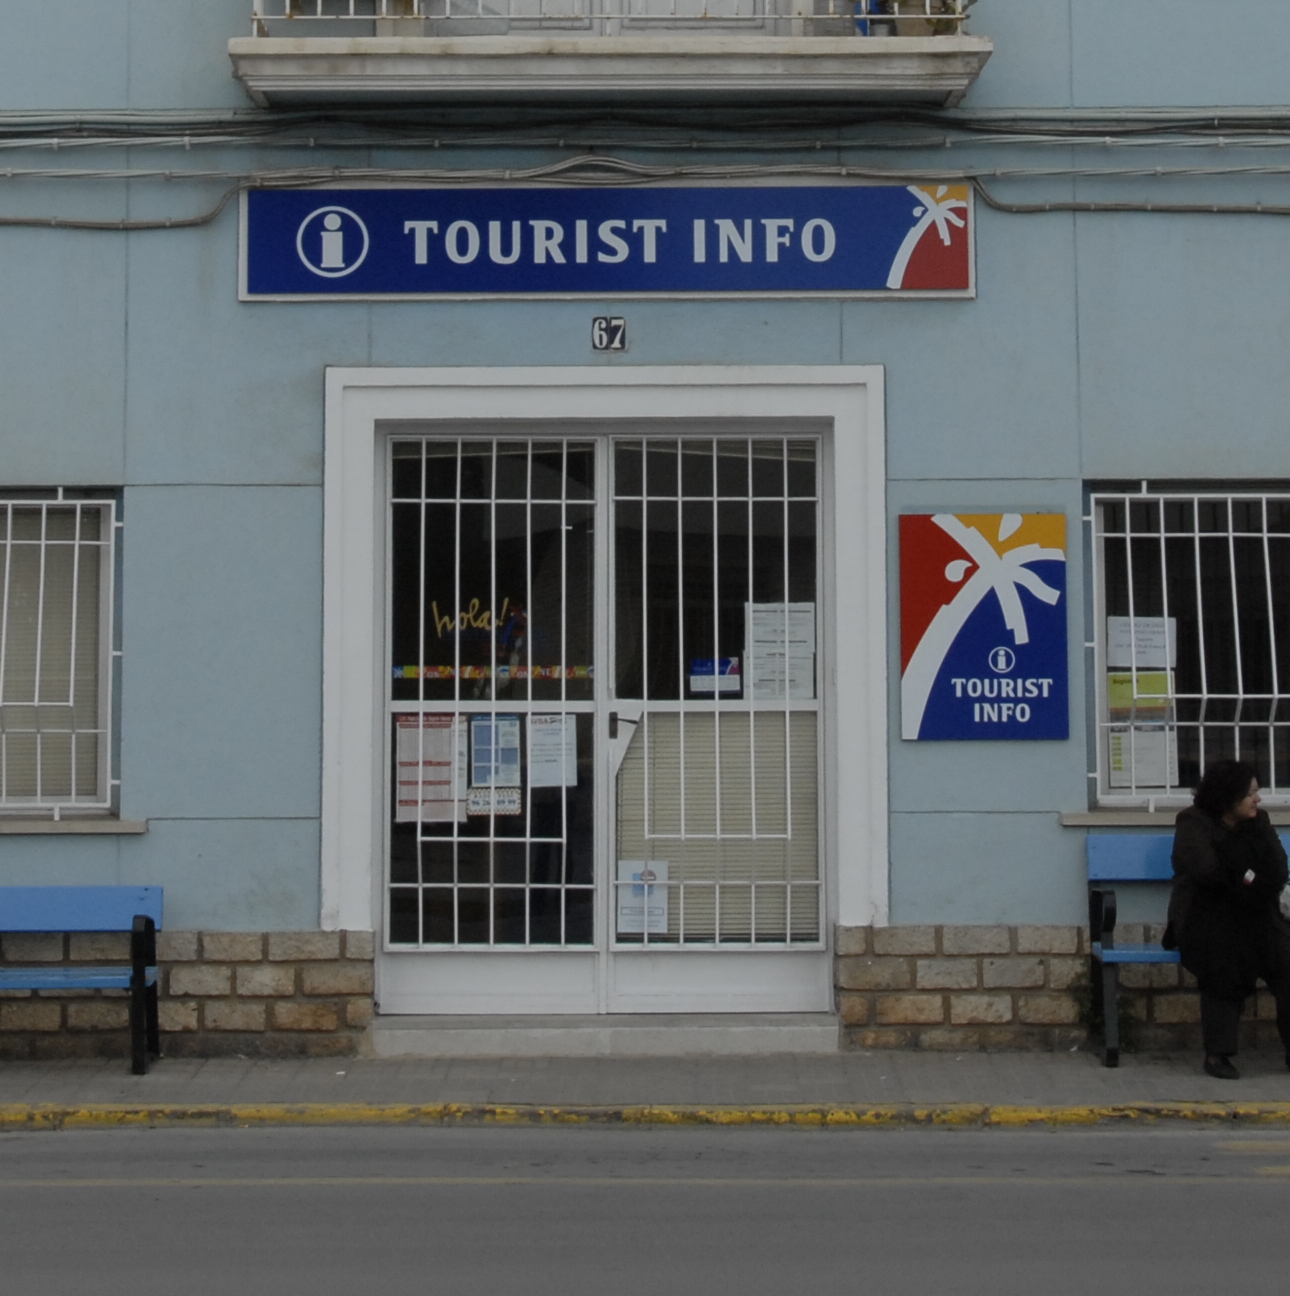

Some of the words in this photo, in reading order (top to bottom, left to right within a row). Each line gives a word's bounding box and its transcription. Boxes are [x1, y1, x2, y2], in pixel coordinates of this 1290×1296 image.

[403, 219, 668, 266] TOURIST
[693, 217, 837, 264] INFO
[593, 318, 625, 349] 67
[951, 678, 1054, 698] TOURIST
[973, 702, 1031, 723] INFO
